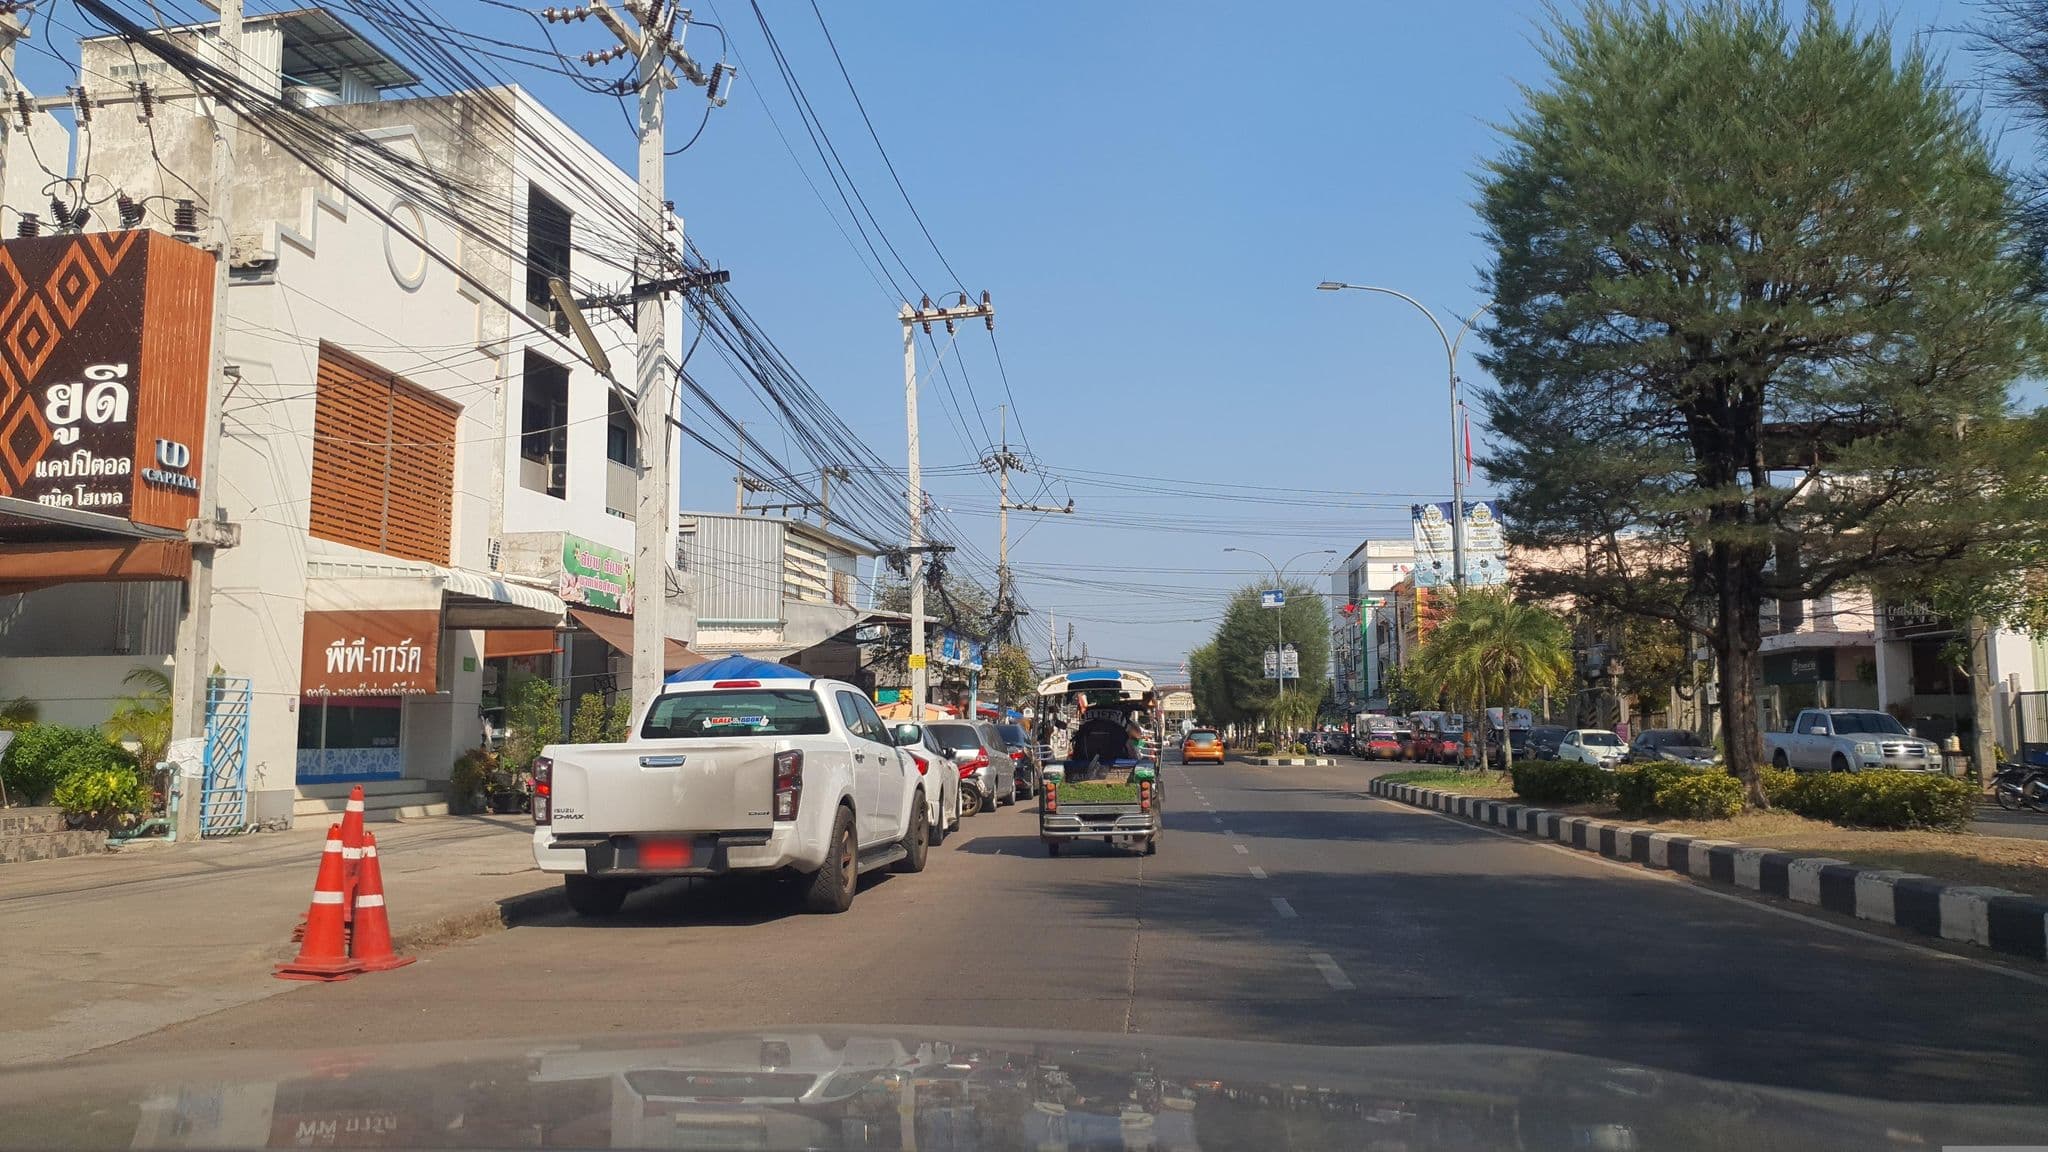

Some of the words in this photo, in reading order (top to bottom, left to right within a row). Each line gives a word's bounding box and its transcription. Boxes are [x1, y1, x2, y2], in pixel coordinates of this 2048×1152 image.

[45, 363, 130, 445] ยูดี
[143, 467, 199, 490] CAPITAL
[76, 483, 123, 506] โฮเทล
